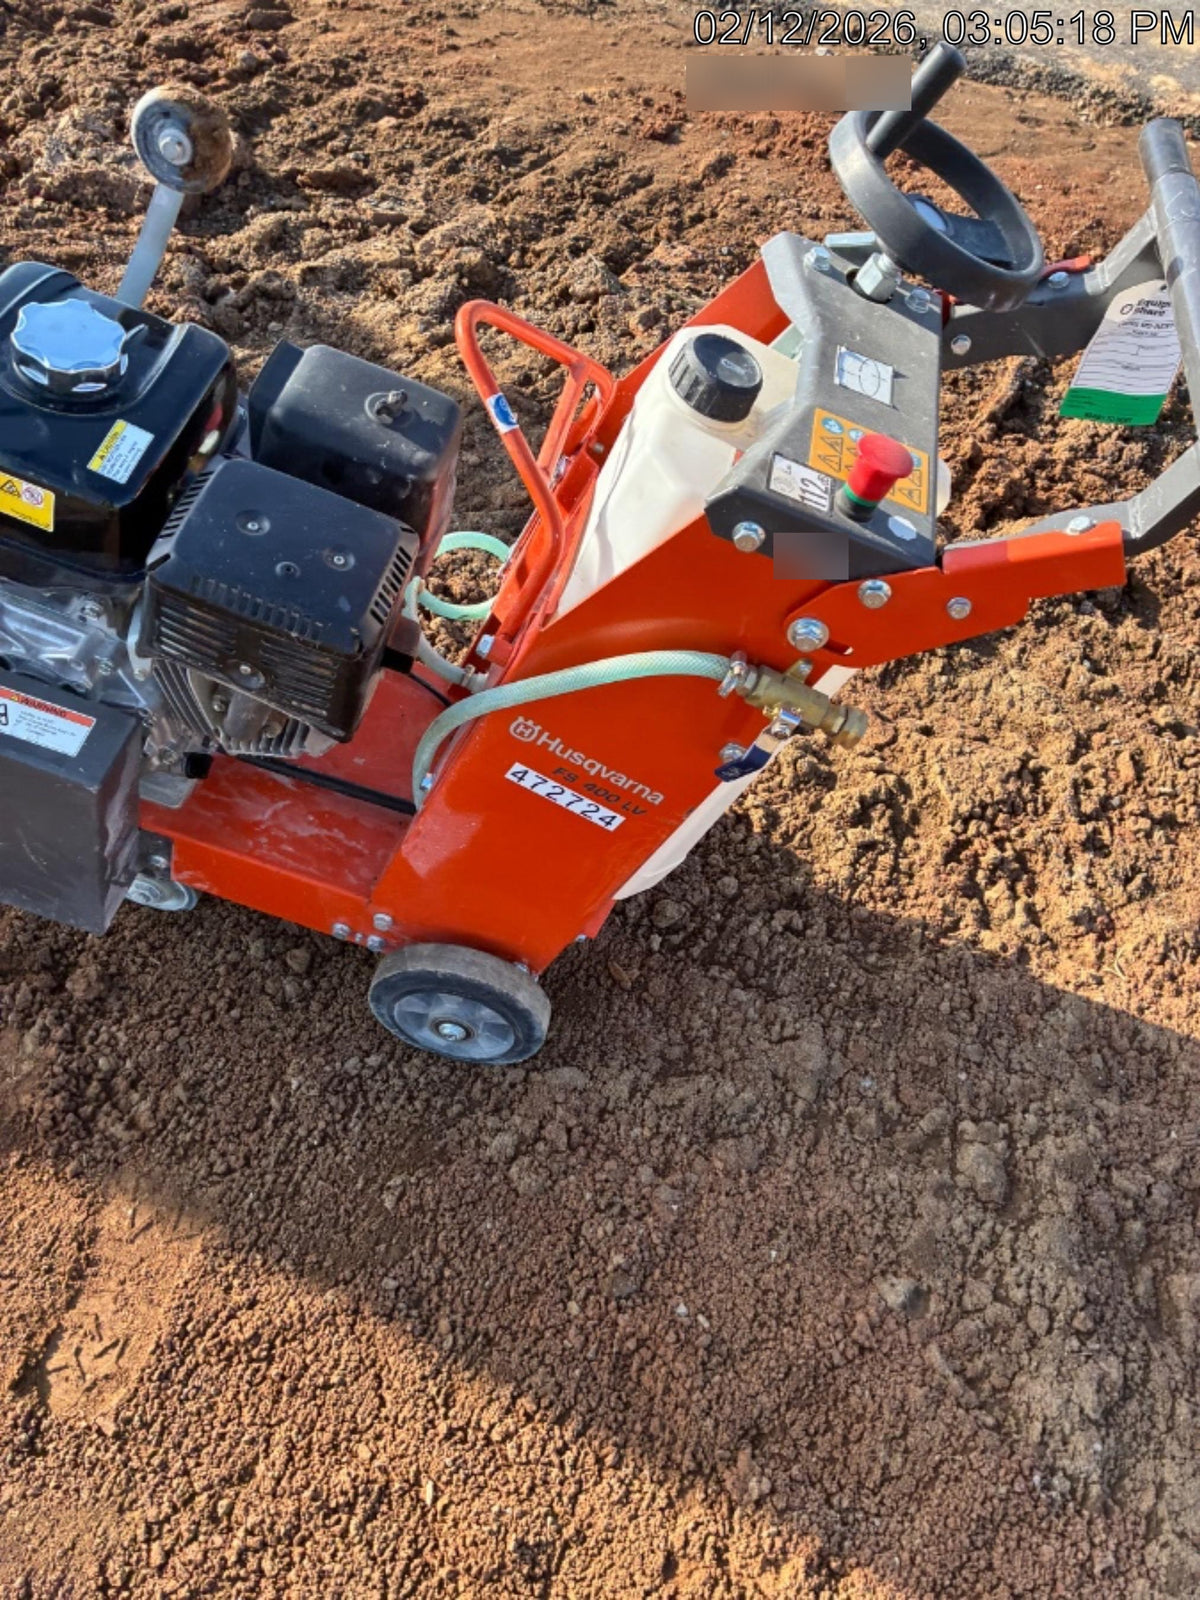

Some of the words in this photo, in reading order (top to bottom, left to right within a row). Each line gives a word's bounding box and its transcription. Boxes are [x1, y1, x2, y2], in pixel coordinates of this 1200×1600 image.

[536, 731, 665, 806] Husqvarna
[553, 767, 579, 783] FS
[583, 782, 621, 803] 400
[510, 769, 618, 828] 472724
